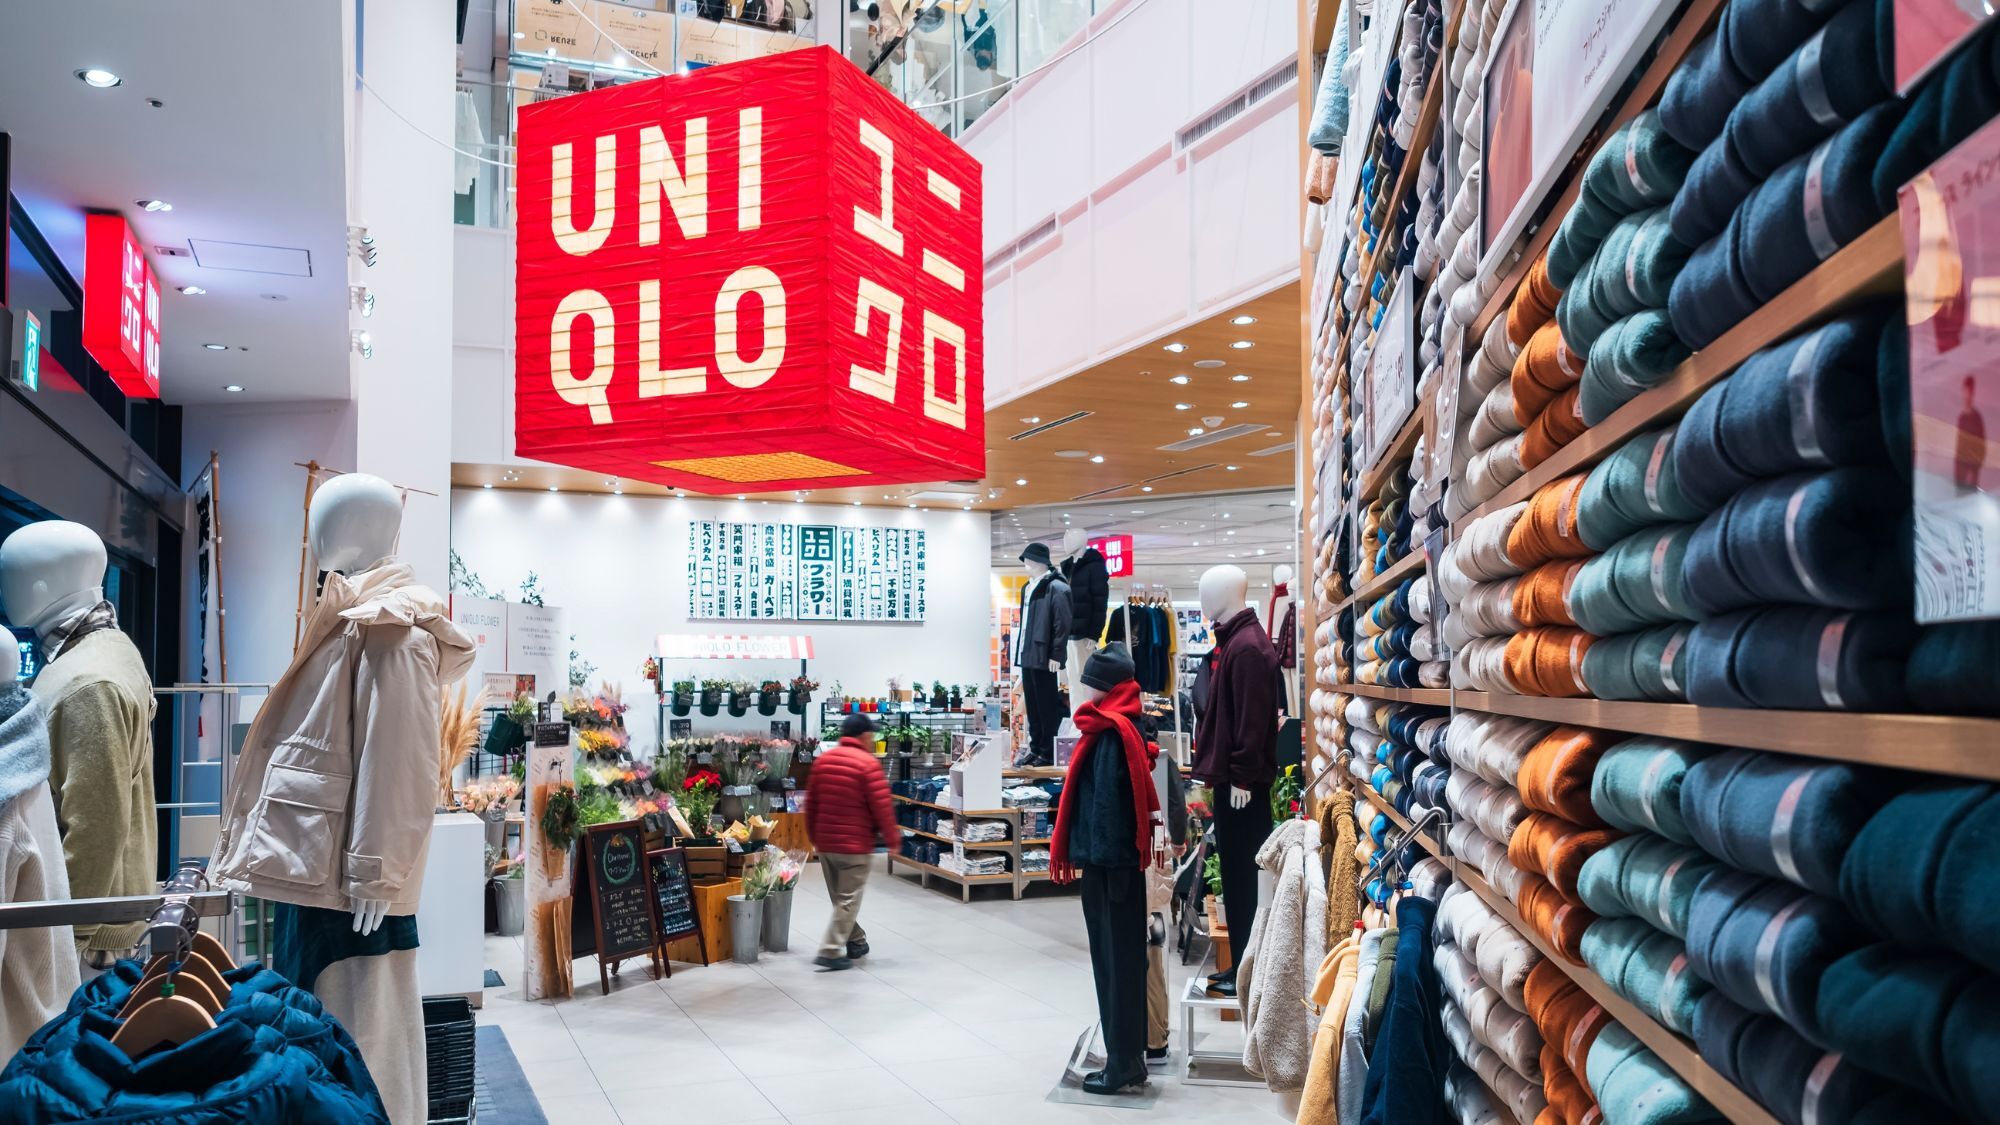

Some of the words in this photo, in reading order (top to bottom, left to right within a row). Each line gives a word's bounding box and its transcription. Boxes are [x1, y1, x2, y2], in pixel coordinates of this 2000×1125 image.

[551, 106, 762, 256] UNI
[853, 118, 966, 292] ユニ
[123, 296, 141, 353] クロ
[146, 278, 160, 333] UNI
[145, 329, 160, 379] QLO
[550, 265, 786, 425] QLO
[850, 277, 966, 430] クロ
[803, 545, 830, 558] クロ
[804, 530, 830, 543] ユニ
[1106, 540, 1121, 557] UNI
[810, 564, 825, 615] フラワー
[1106, 557, 1123, 575] QLO
